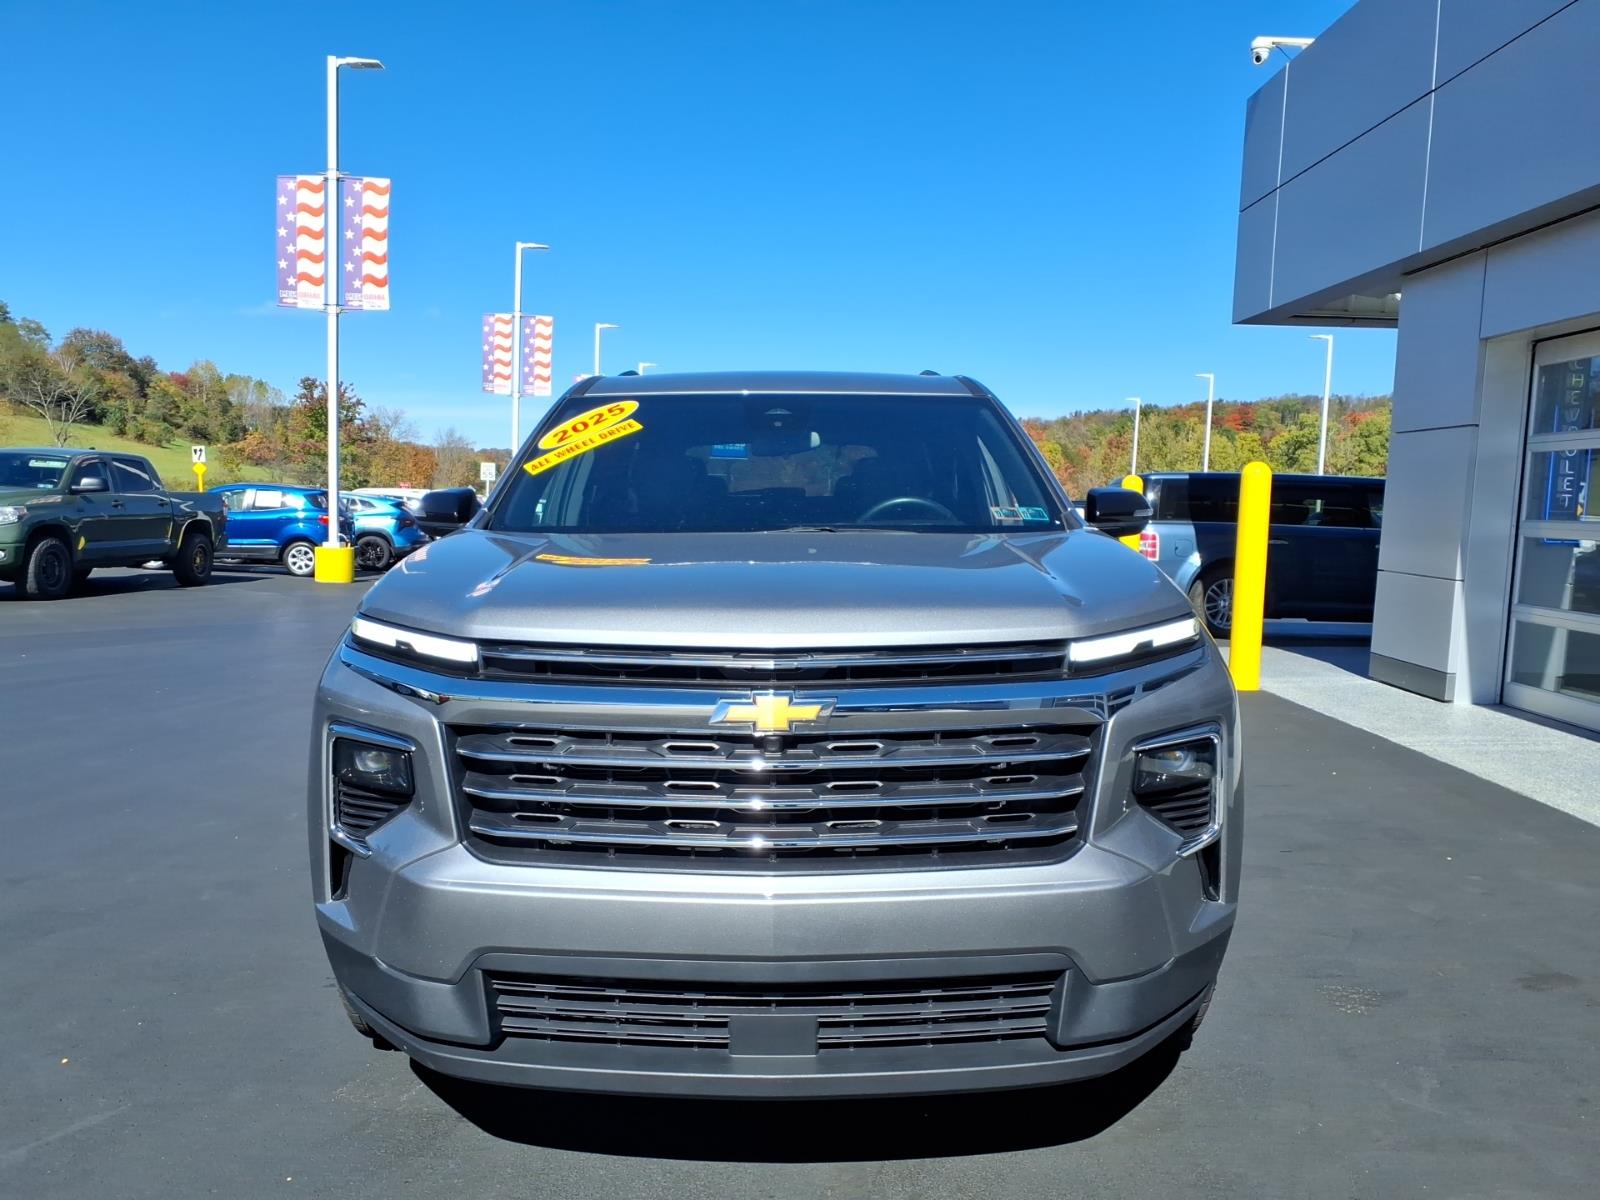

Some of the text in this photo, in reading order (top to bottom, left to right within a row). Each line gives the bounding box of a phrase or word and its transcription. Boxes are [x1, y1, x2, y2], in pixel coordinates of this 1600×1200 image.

[553, 404, 625, 443] 2025
[531, 421, 635, 471] ALL WHEEL DRIVE
